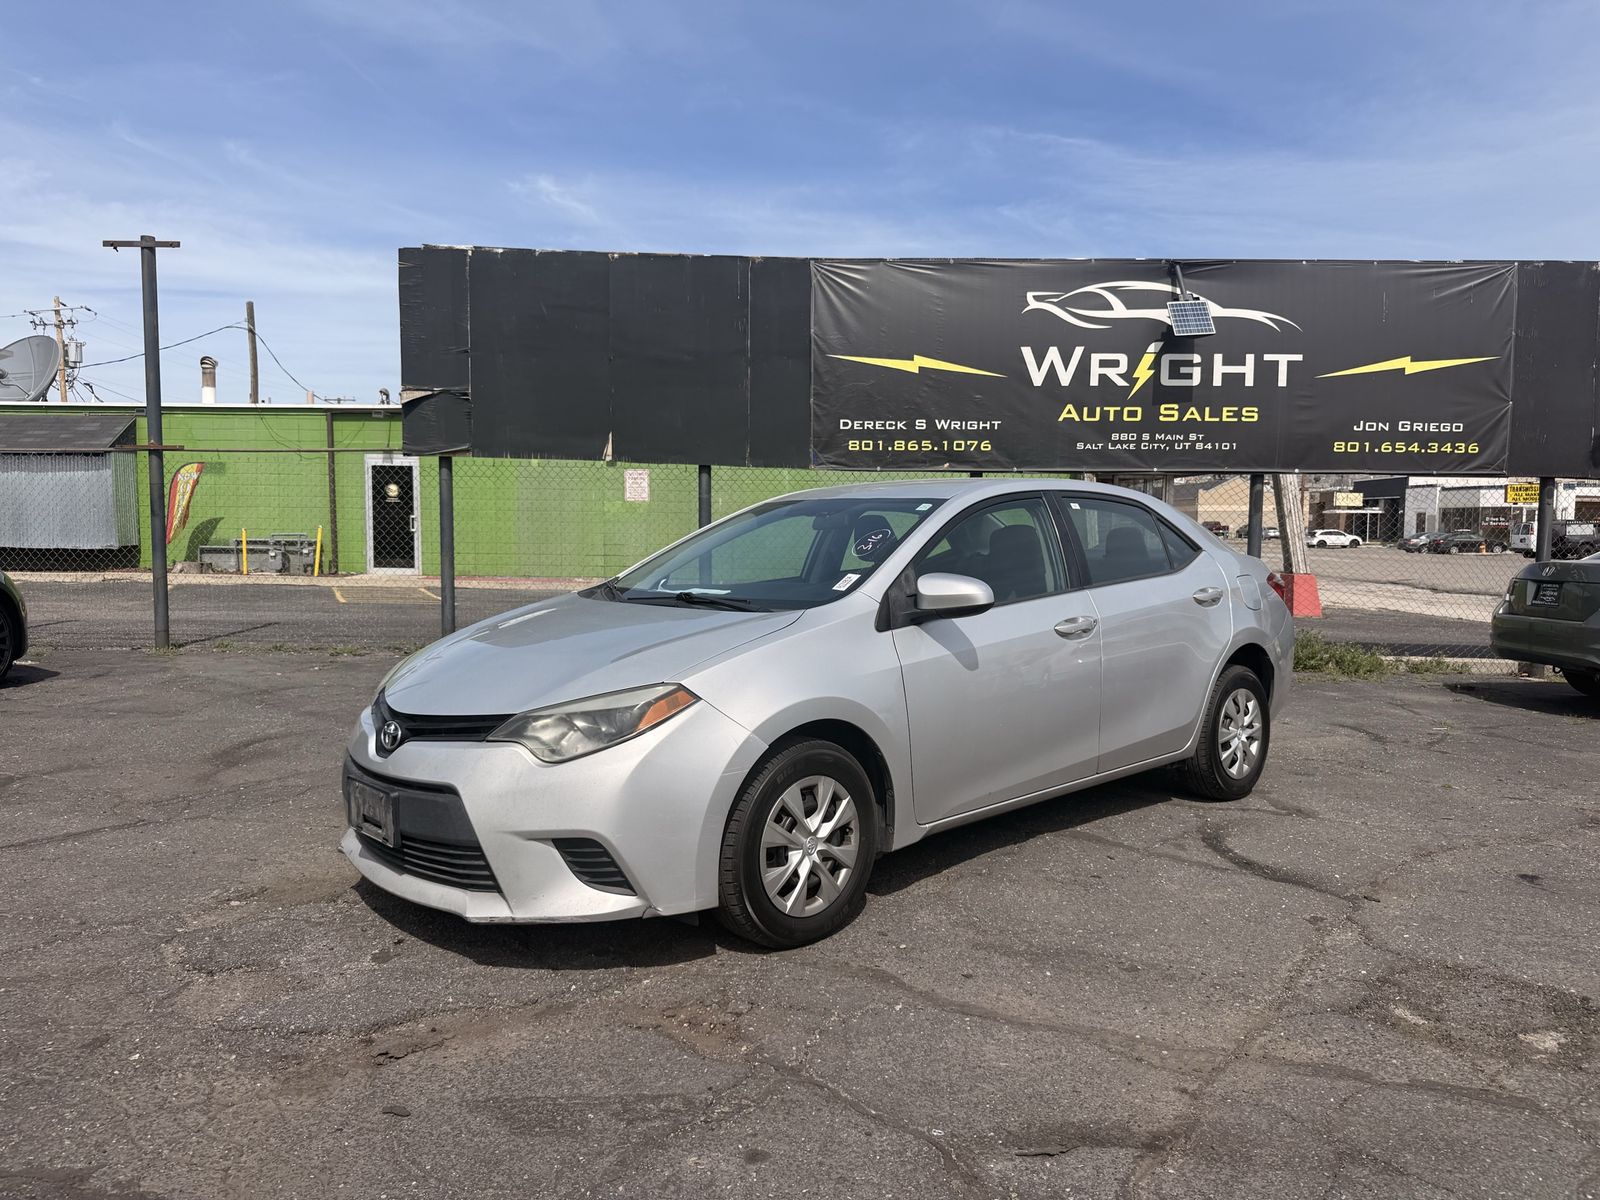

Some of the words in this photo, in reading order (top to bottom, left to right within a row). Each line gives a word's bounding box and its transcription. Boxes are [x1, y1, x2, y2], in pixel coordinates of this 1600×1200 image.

[1057, 403, 1143, 422] AUTO
[1158, 403, 1260, 422] SALES
[839, 418, 908, 431] DERECK
[914, 418, 927, 430] S
[934, 418, 1002, 430] WRIGHT
[1353, 420, 1390, 432] JON
[1397, 420, 1464, 432] GRIEGO
[1111, 432, 1137, 441] 880
[1141, 432, 1150, 441] S
[1155, 433, 1184, 441] MAIN
[1188, 433, 1205, 441] ST
[848, 439, 992, 452] 801.865.1076
[1076, 441, 1104, 450] SALT
[1108, 441, 1137, 450] LAKE
[1140, 441, 1170, 452] CITY,
[1174, 442, 1192, 450] UT
[1195, 442, 1238, 450] 84101
[1333, 441, 1480, 454] 801.654.3436
